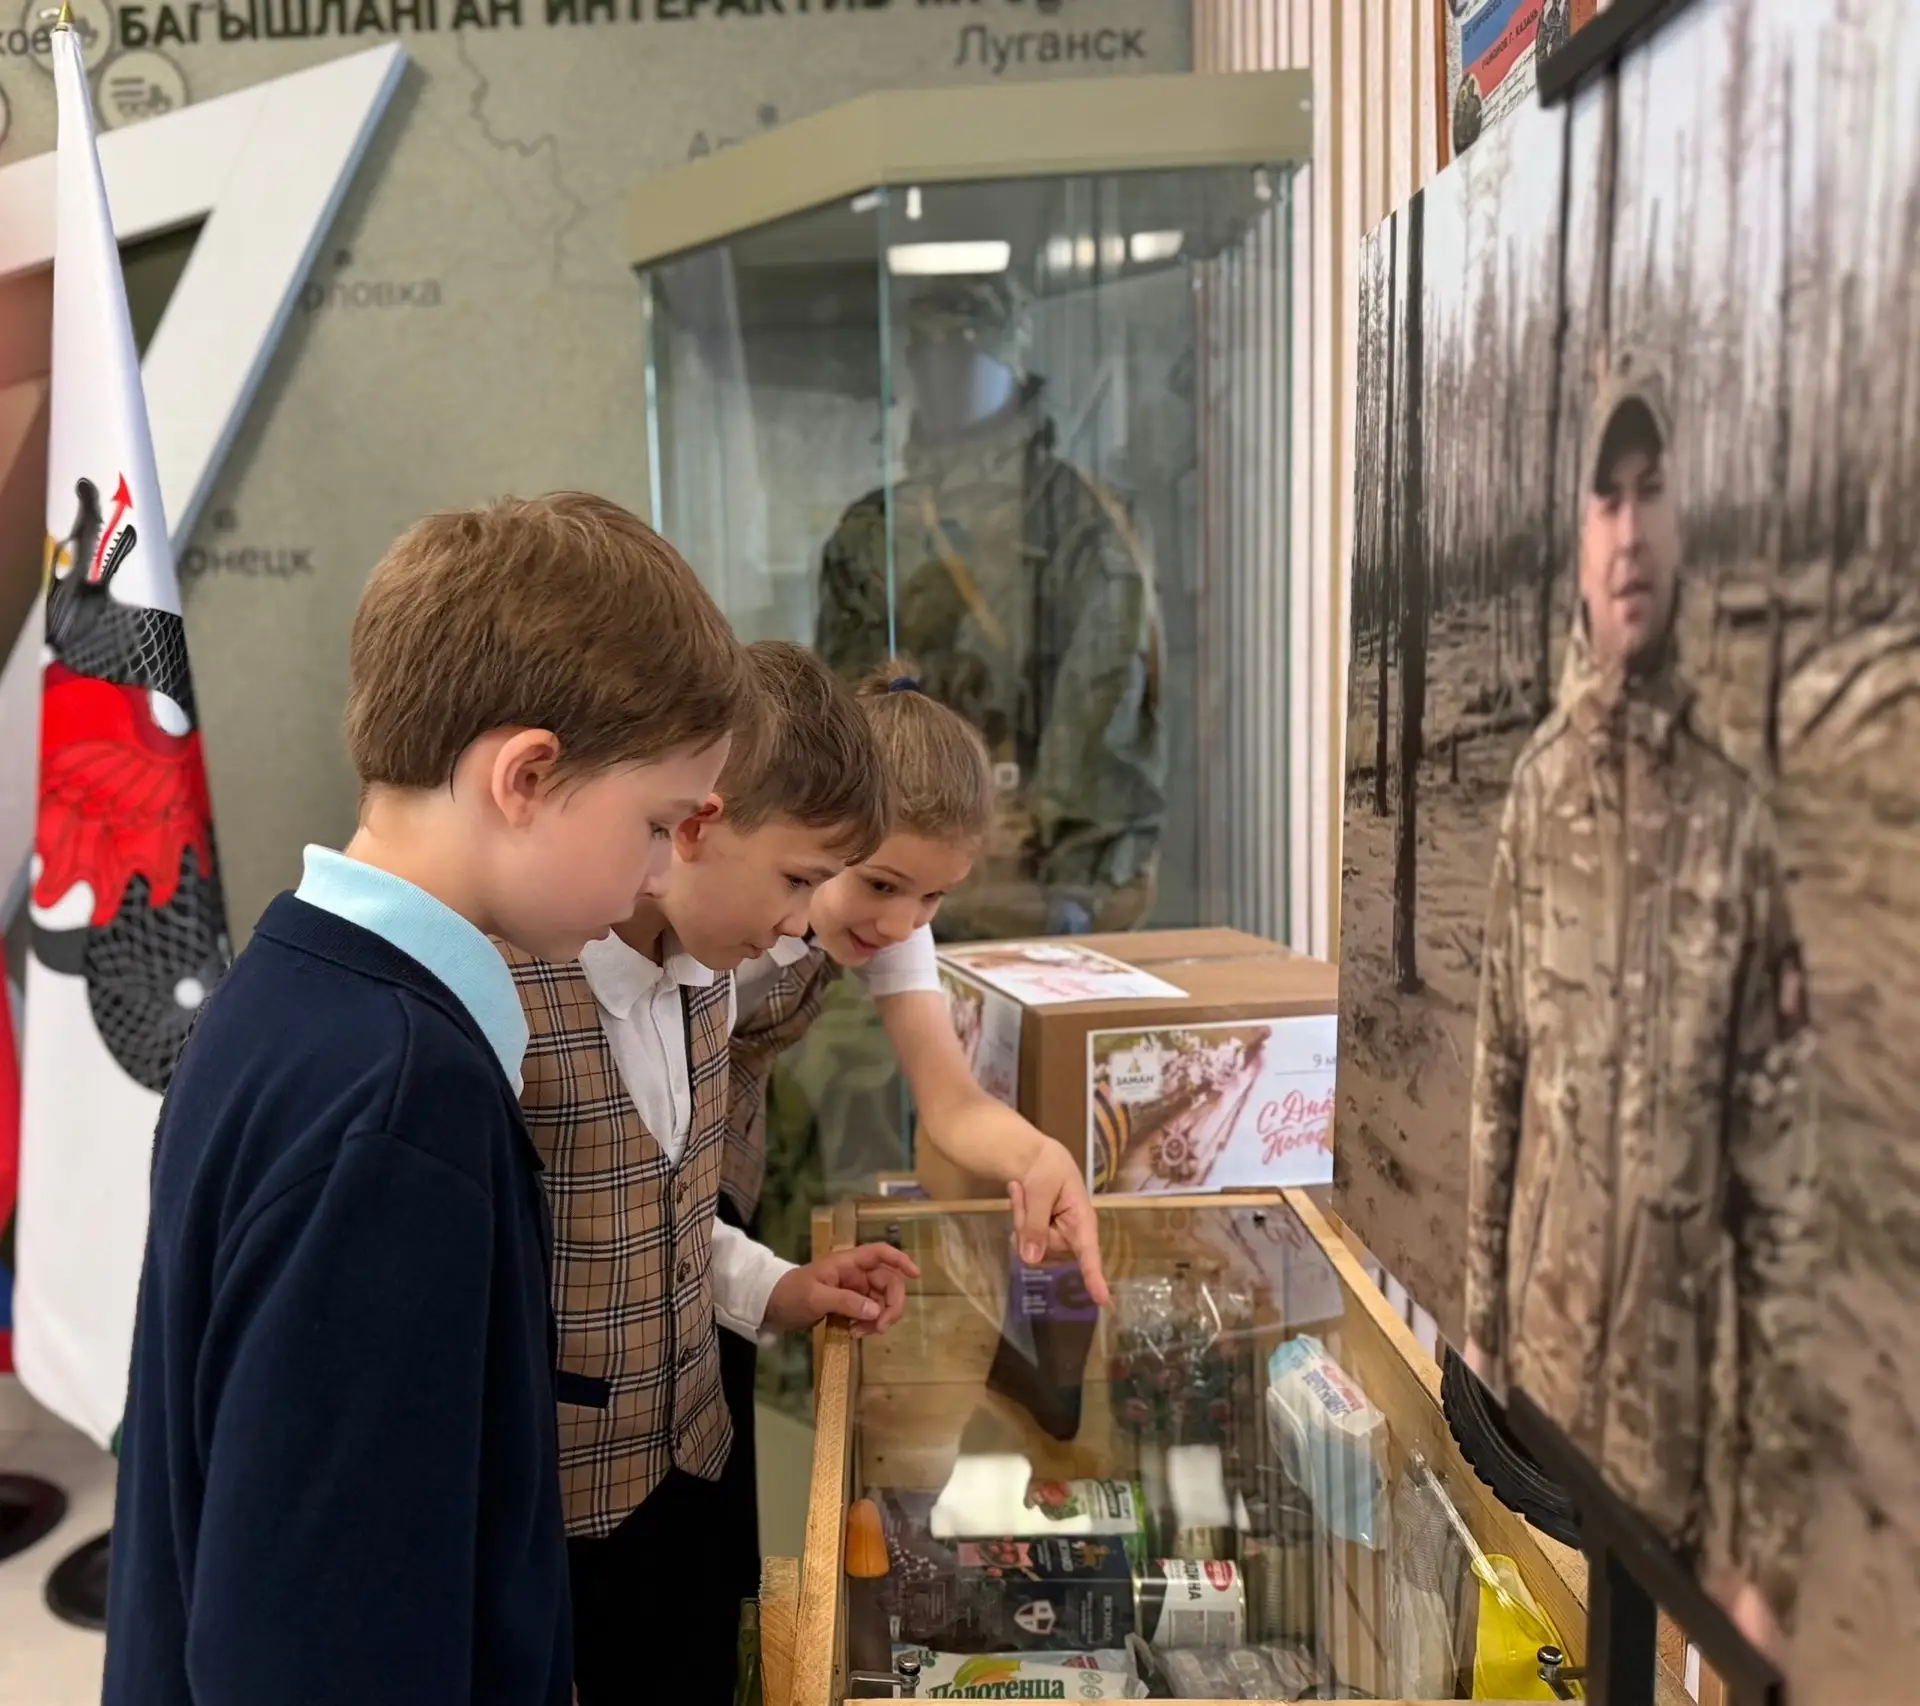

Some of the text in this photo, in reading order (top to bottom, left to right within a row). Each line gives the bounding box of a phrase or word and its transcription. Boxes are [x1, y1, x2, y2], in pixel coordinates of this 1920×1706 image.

[119, 0, 523, 47] БАГЫШЛАНГАН
[953, 24, 1146, 76] Луганск
[181, 545, 317, 583] онецк
[1312, 1053, 1323, 1068] 9
[1257, 1100, 1278, 1134] С
[928, 1679, 1065, 1699] Полотенца
